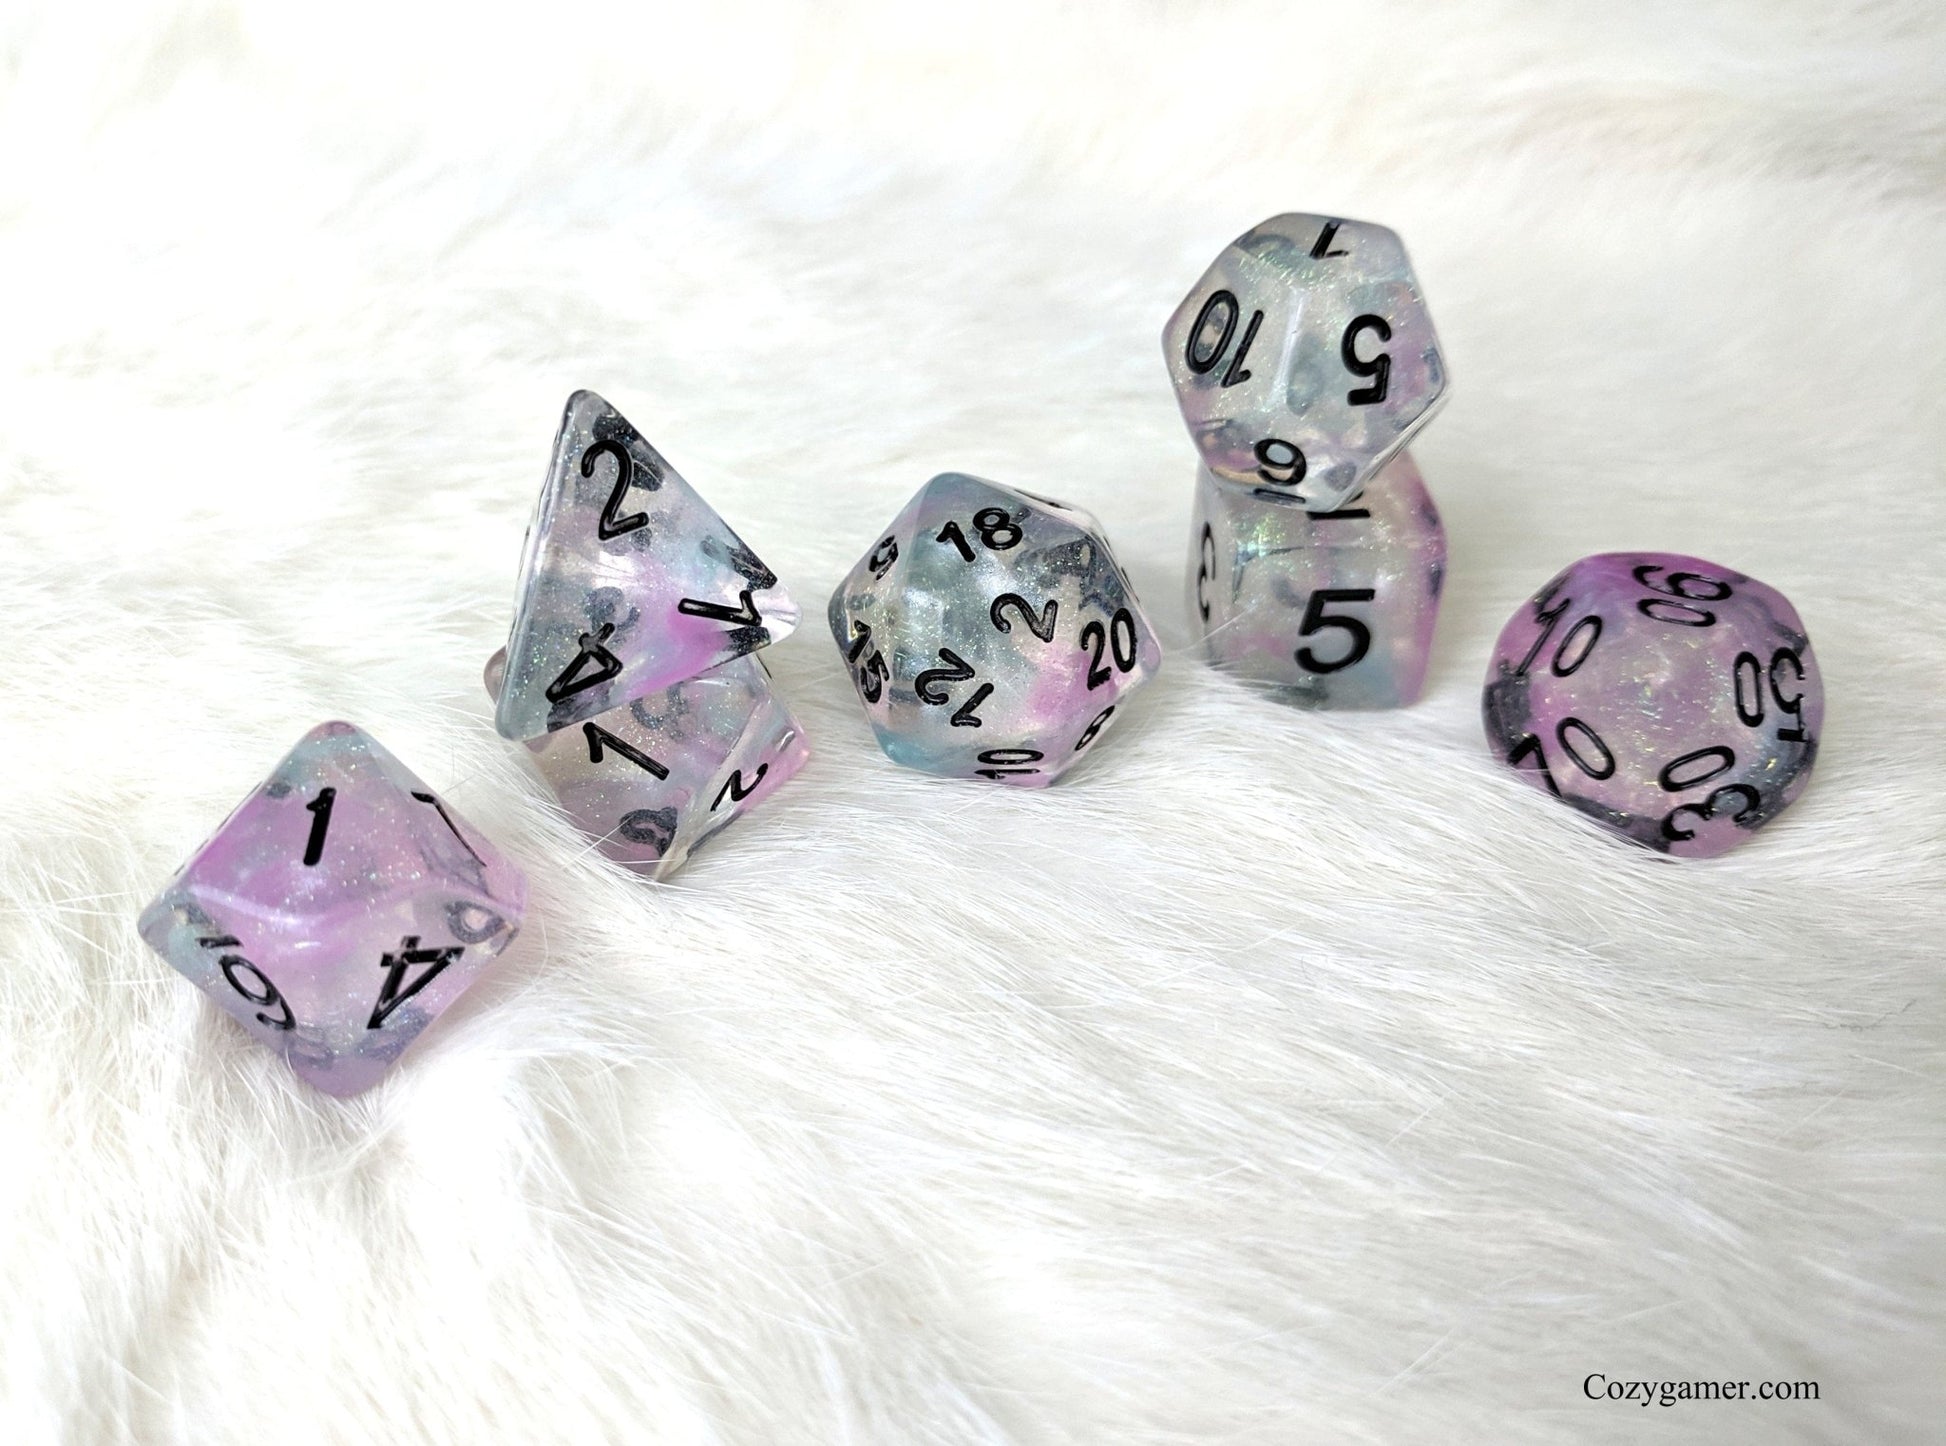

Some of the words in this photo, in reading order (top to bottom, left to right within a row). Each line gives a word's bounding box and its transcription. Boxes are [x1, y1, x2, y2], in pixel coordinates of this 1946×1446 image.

[1185, 290, 1264, 387] 10
[1341, 314, 1391, 405] 5
[581, 440, 649, 541] 2
[937, 508, 1023, 562] 18
[990, 592, 1058, 643] 2
[1080, 608, 1138, 691] 20
[1294, 588, 1376, 674] 5
[1515, 597, 1603, 678] 10
[546, 622, 623, 703] 4
[1507, 716, 1616, 799] 70
[1659, 745, 1761, 842] 30
[303, 786, 337, 867] 1
[367, 935, 466, 1031] 4
